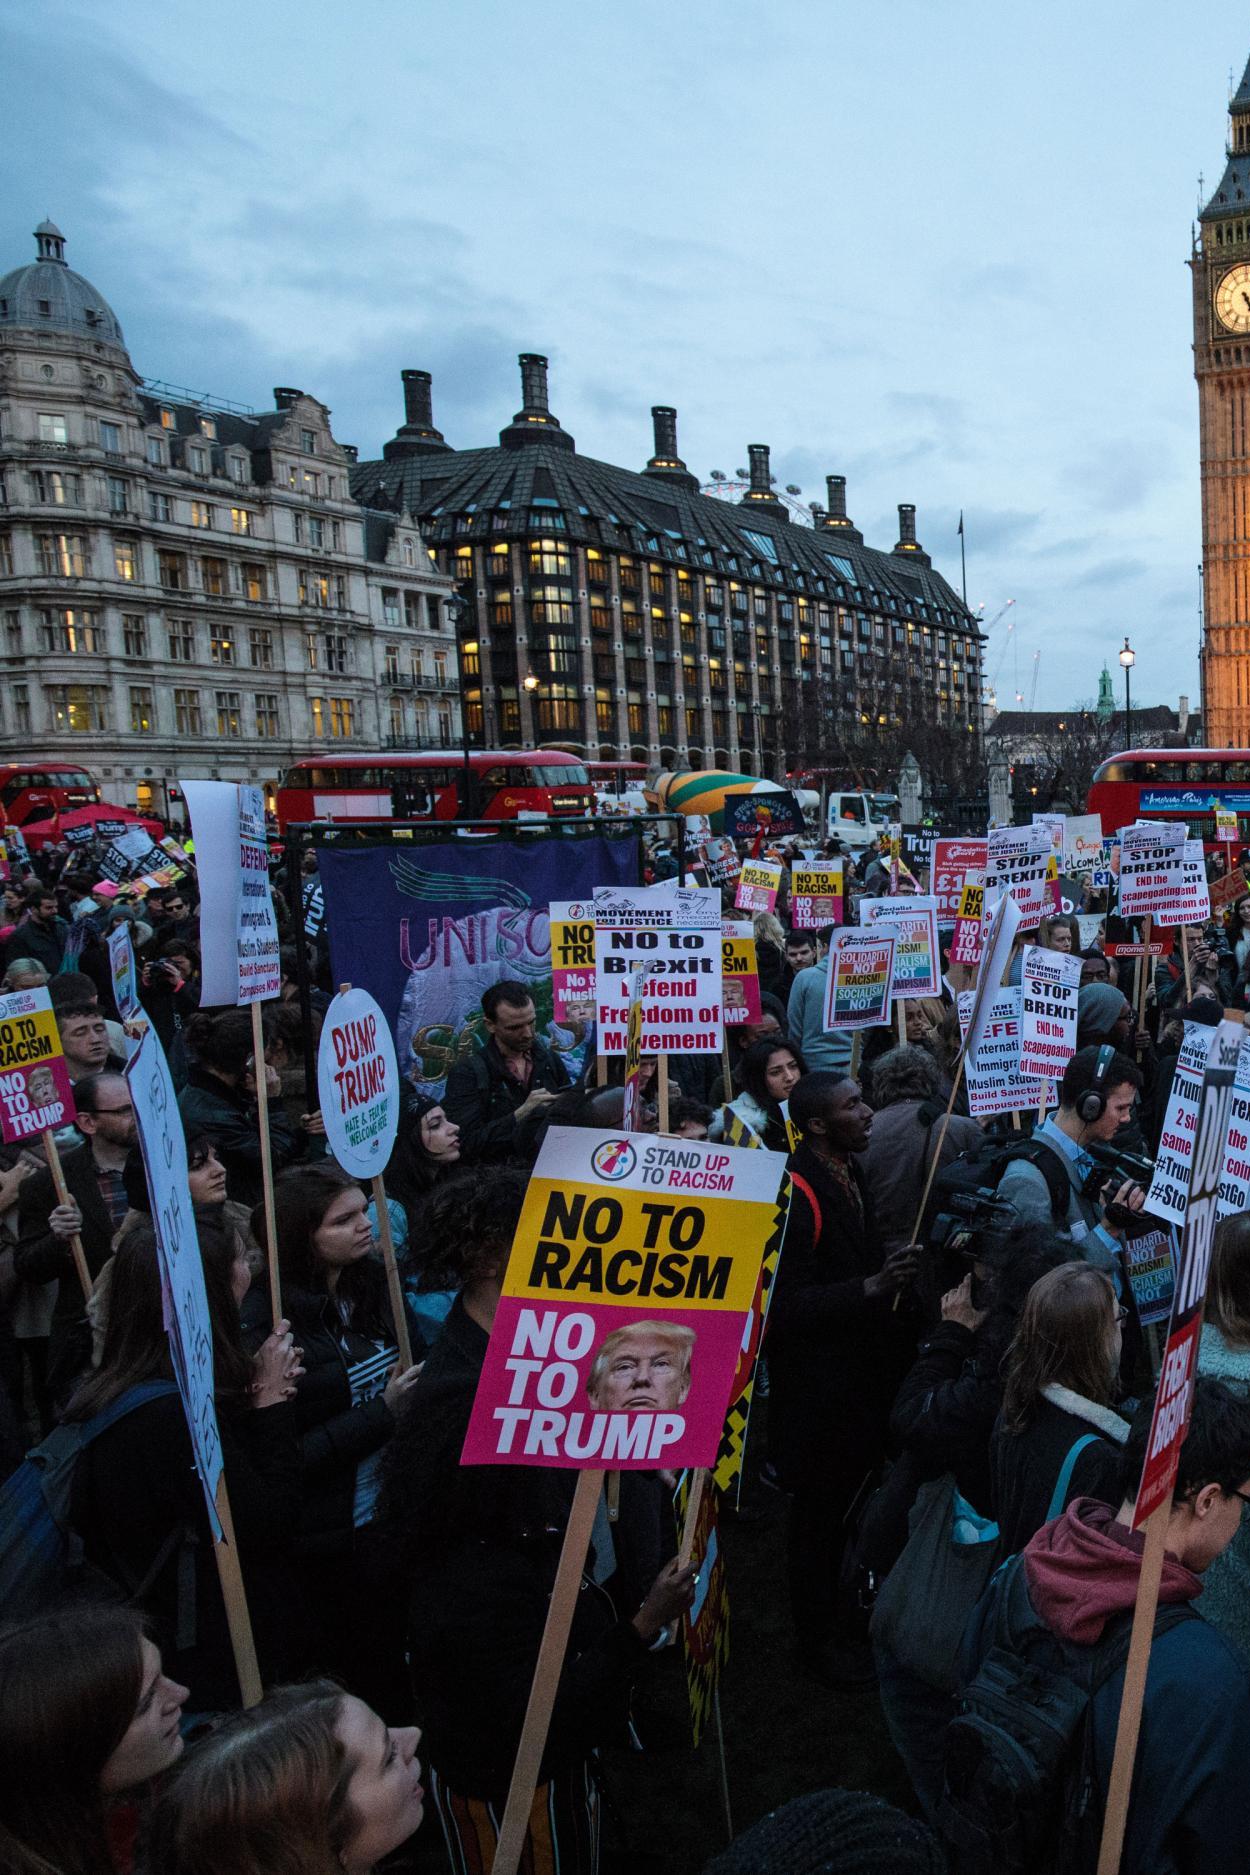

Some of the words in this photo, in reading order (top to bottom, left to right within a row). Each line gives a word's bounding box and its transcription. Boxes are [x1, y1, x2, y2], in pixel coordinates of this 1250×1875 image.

[96, 823, 126, 832] Trump
[240, 844, 268, 871] DEFEND
[1130, 848, 1176, 861] STOP
[996, 854, 1042, 871] STOP
[1121, 859, 1181, 874] BREXIT
[744, 868, 757, 878] NO
[759, 870, 770, 880] TO
[796, 874, 812, 883] NO
[814, 874, 829, 883] TO
[1136, 876, 1152, 887] END
[1154, 875, 1168, 885] the
[743, 875, 775, 889] RACISM
[796, 884, 837, 894] RACISM
[796, 897, 812, 907] NO
[1122, 887, 1181, 902] scapegoating
[738, 900, 769, 911] TRUMP
[797, 907, 810, 917] TO
[1121, 907, 1131, 916] of
[1131, 899, 1180, 914] immigrants
[595, 909, 673, 918] MOVEMENT
[1160, 910, 1208, 924] Movement
[960, 920, 979, 935] NO
[399, 906, 552, 972] UNISO
[611, 932, 658, 949] NO
[667, 932, 704, 949] to
[959, 935, 976, 948] TO
[840, 950, 889, 963] SOLIDARITY
[239, 963, 254, 977] Build
[254, 961, 279, 976] Sanctuary
[852, 962, 876, 974] NOT
[845, 973, 880, 986] RACISM!
[239, 984, 266, 999] Campuses
[838, 985, 885, 1000] SOCIALISM
[1031, 981, 1071, 1000] STOP
[849, 999, 872, 1010] NOT
[1024, 998, 1077, 1021] BREXIT
[698, 1005, 720, 1023] of
[16, 1018, 37, 1038] TO
[1036, 1020, 1051, 1035] END
[1051, 1025, 1064, 1038] the
[331, 1014, 376, 1068] DUMP
[1020, 1060, 1029, 1072] of
[0, 1072, 26, 1096] NO
[334, 1055, 385, 1115] TRUMP
[968, 1075, 1006, 1090] Muslim
[970, 1090, 997, 1100] Build
[3, 1094, 30, 1116] TO
[970, 1101, 1025, 1112] Campuses
[9, 1102, 65, 1136] TRUMP
[1175, 1108, 1184, 1126] 2
[1161, 1131, 1192, 1156] same
[1228, 1129, 1248, 1151] the
[643, 1146, 701, 1168] STAND
[704, 1154, 730, 1171] UP
[641, 1166, 667, 1184] TO
[668, 1170, 735, 1192] RACISM
[540, 1191, 623, 1244] NO
[640, 1202, 705, 1251] TO
[527, 1241, 733, 1300] RACISM
[510, 1309, 596, 1361] NO
[504, 1359, 578, 1408] TO
[492, 1407, 686, 1460] TRUMP
